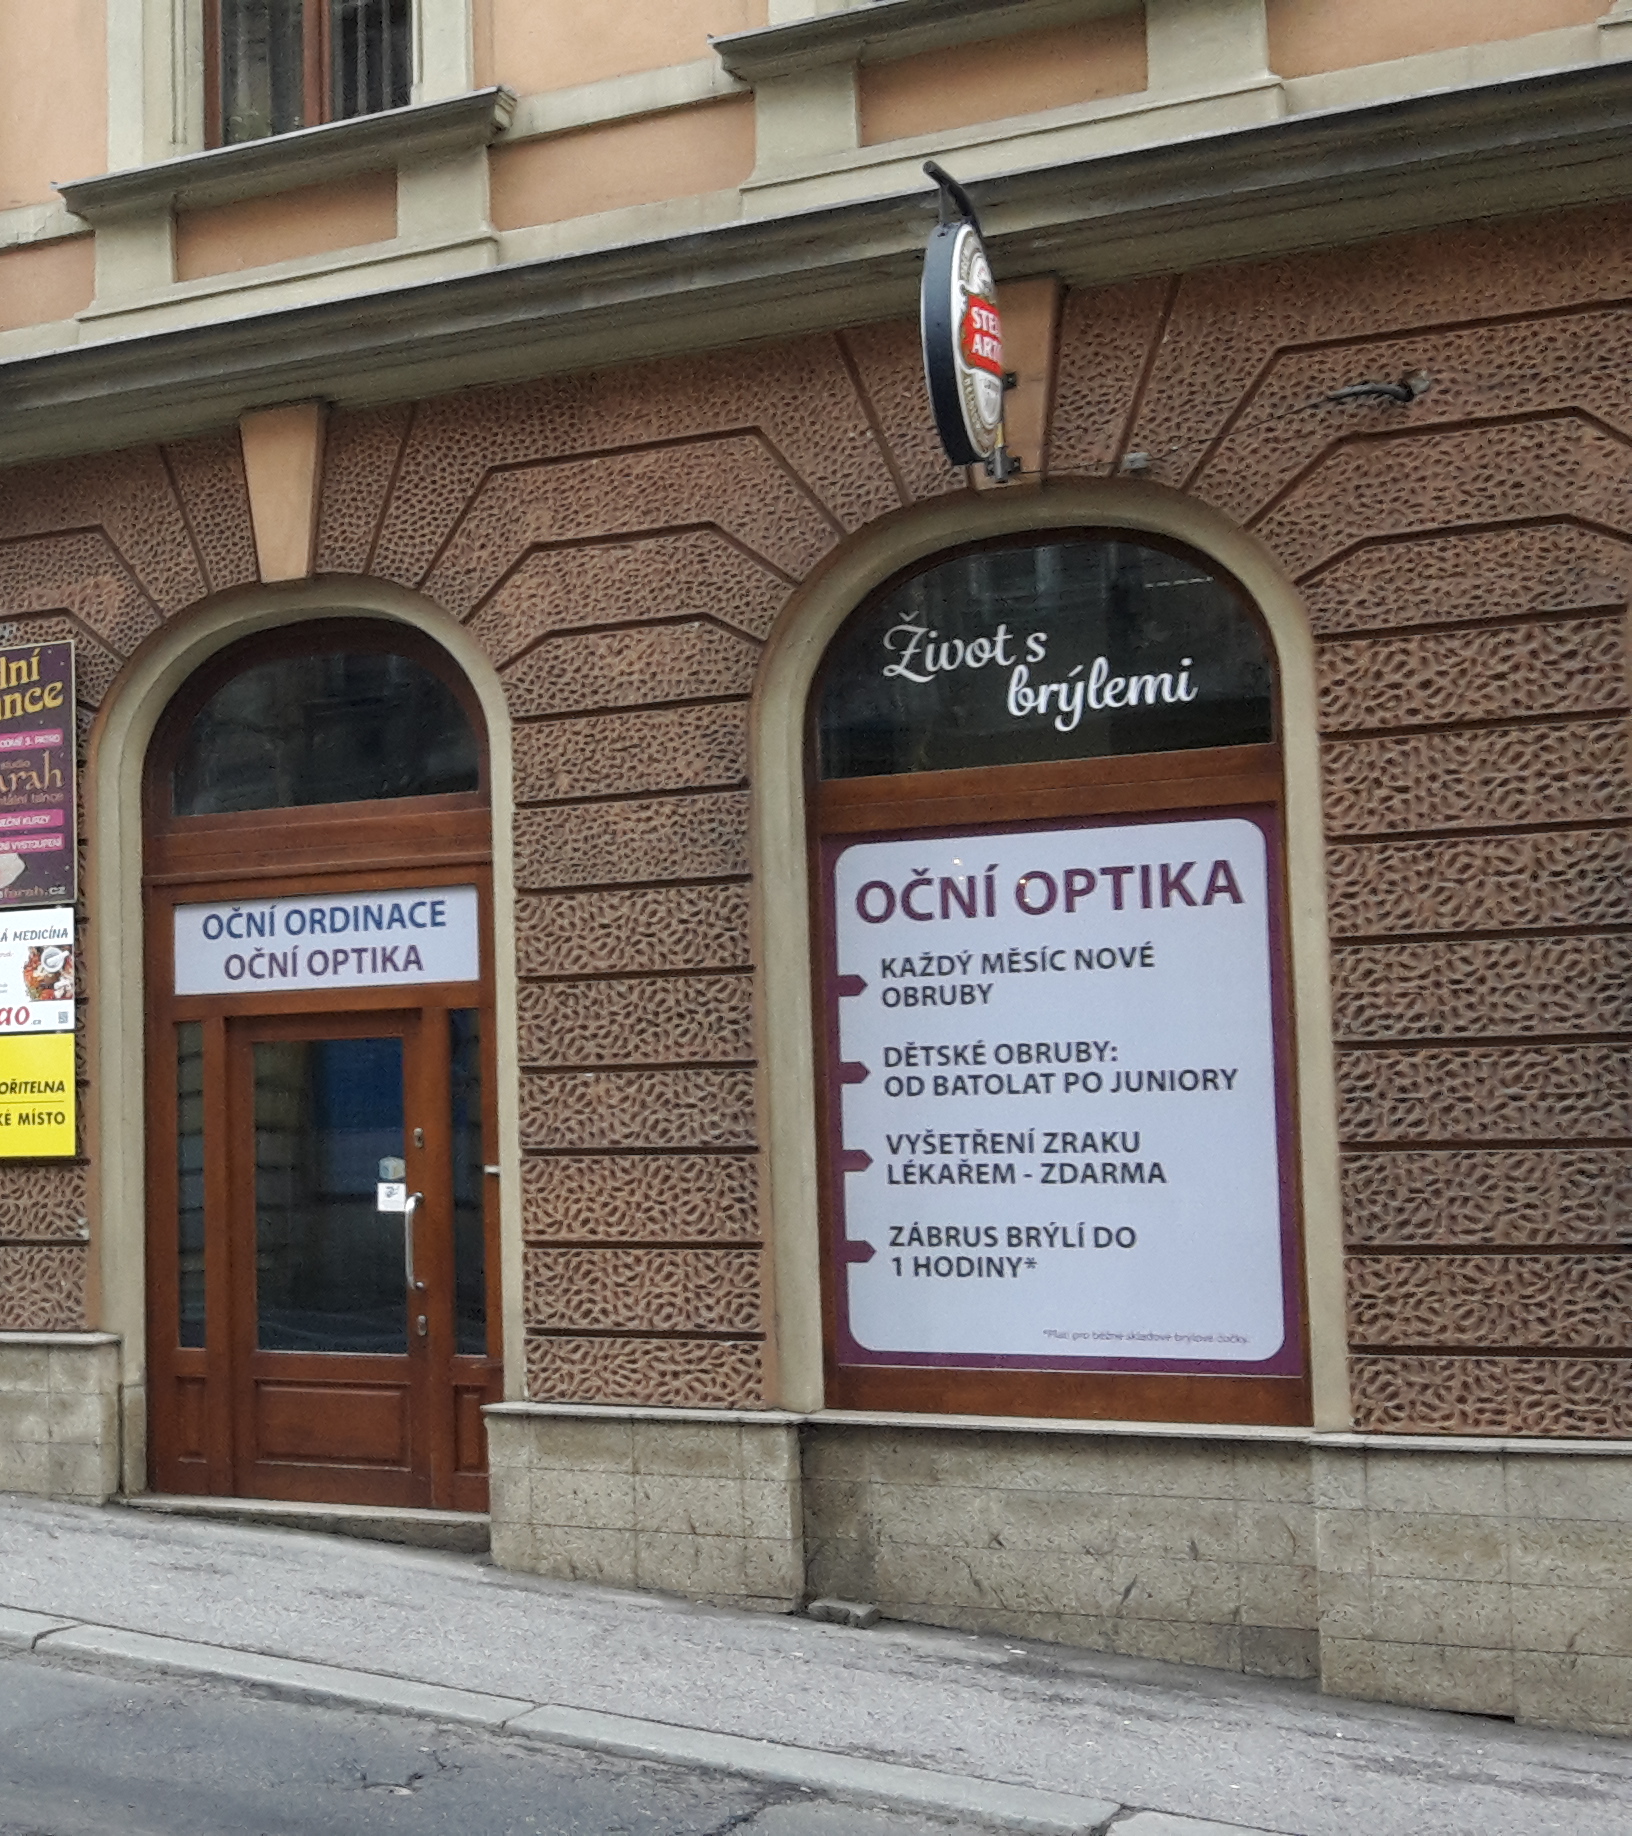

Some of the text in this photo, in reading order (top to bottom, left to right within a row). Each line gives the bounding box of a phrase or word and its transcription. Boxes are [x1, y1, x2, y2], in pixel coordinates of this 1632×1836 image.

[883, 610, 1048, 683] Život s
[1007, 656, 1199, 732] brýlemi
[855, 859, 1245, 924] OČNÍ OPTIKA
[13, 925, 69, 942] MEDICÍNA
[202, 900, 447, 940] OČNÍ ORDINACE
[224, 944, 424, 980] OČNÍ OPTIKA
[881, 941, 1155, 978] KAŽDÝ MĚSÍC NOVÉ
[881, 983, 994, 1009] OBRUBY
[883, 1039, 1119, 1069] DĚTSKÉ OBRUBY:
[884, 1068, 1239, 1098] OD BATOLAT PO JUNIORY
[18, 1108, 65, 1126] MÍSTO
[886, 1127, 1141, 1156] VYŠETŘENÍ ZRAKU
[887, 1158, 1015, 1186] LÉKAŘEM
[1041, 1162, 1167, 1186] ZDARMA
[889, 1220, 1137, 1249] ZÁBRUS BRÝLÍ DO
[892, 1256, 903, 1277] 1
